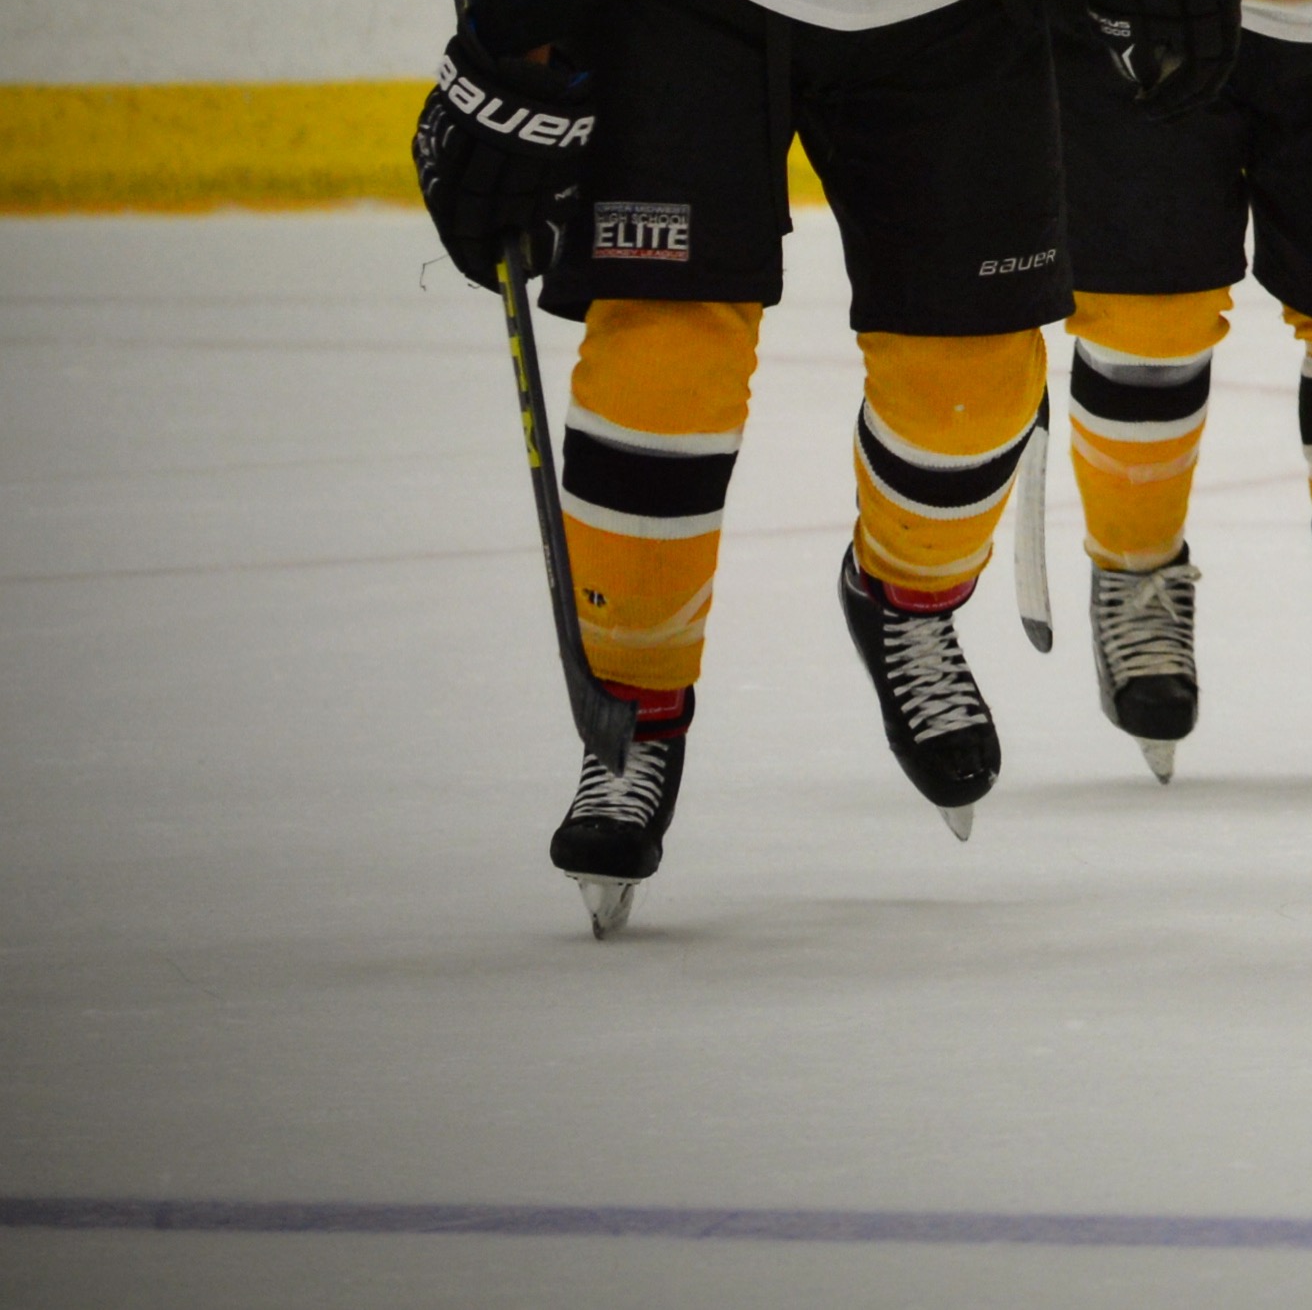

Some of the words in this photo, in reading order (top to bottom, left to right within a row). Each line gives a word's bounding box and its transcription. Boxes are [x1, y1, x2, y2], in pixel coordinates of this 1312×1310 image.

[438, 54, 597, 149] BAUER
[596, 222, 689, 250] ELITE
[978, 248, 1057, 277] BAUER
